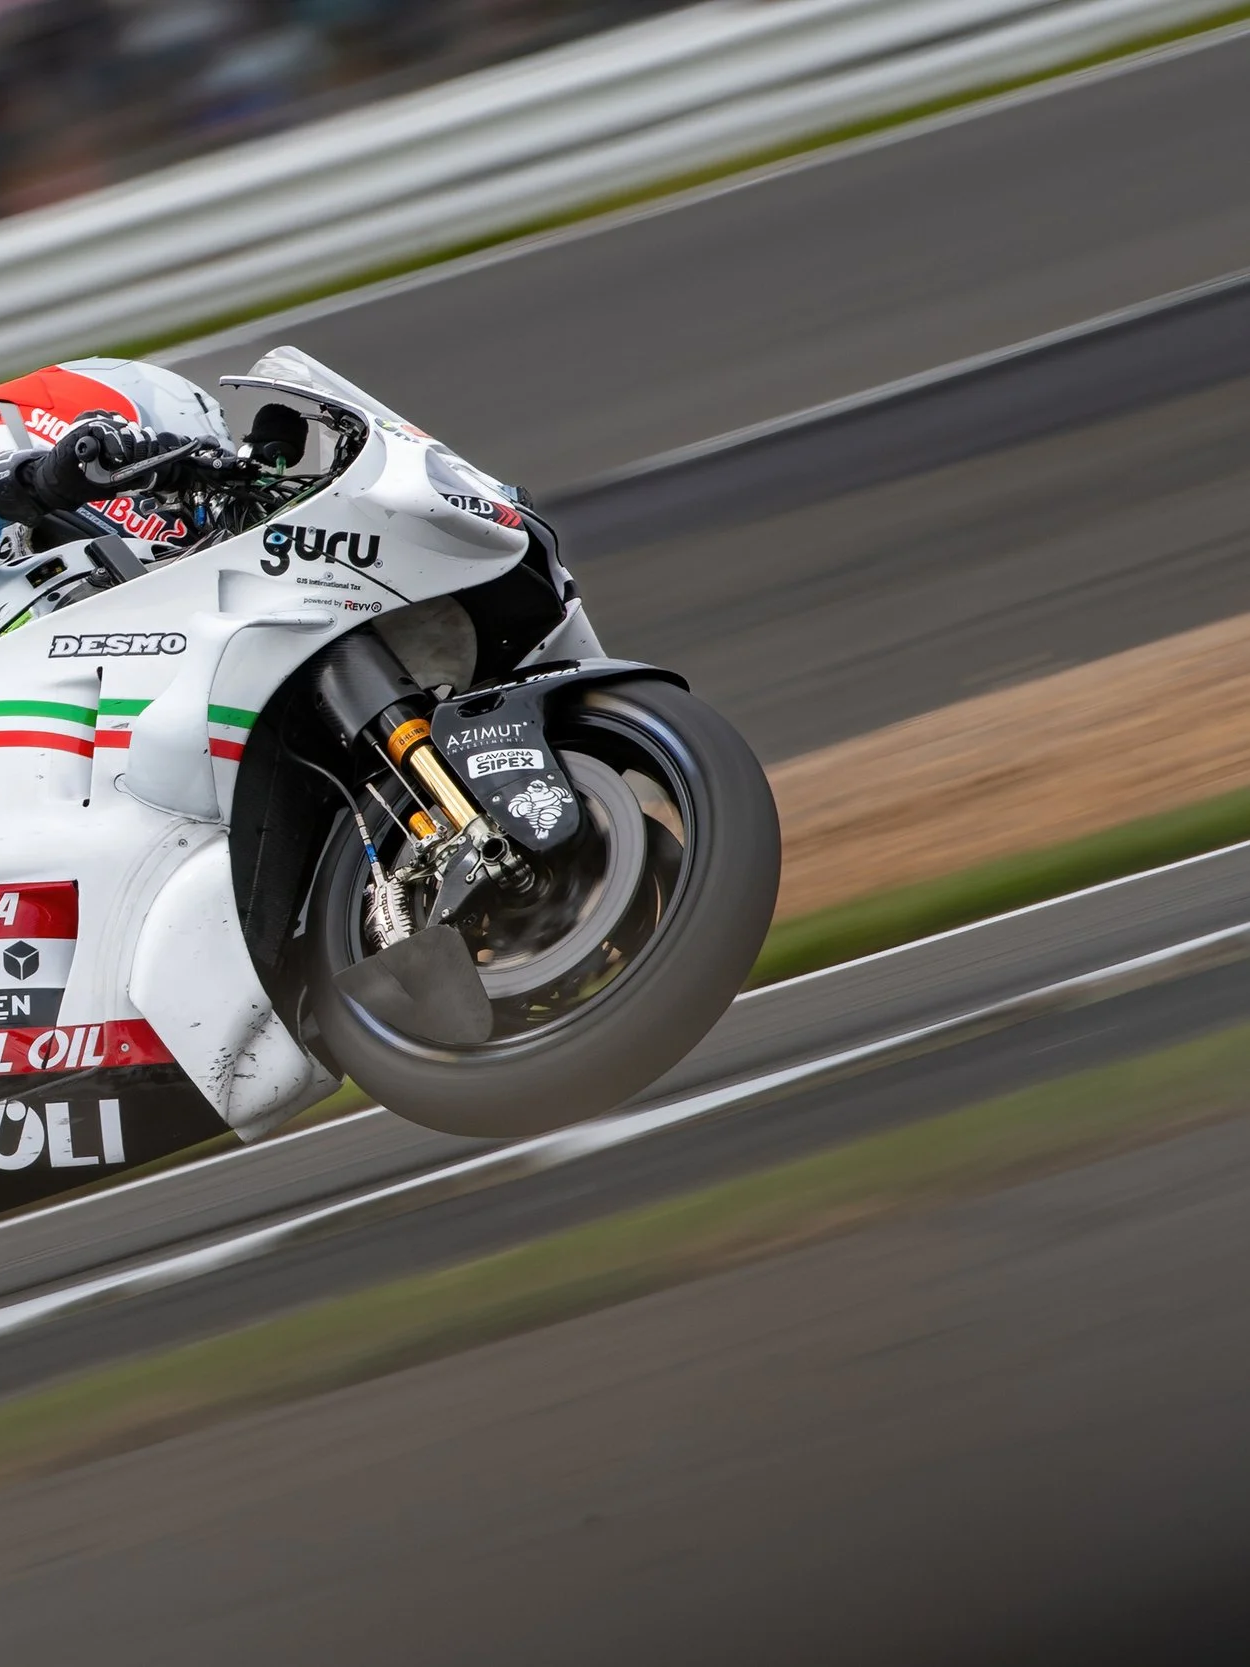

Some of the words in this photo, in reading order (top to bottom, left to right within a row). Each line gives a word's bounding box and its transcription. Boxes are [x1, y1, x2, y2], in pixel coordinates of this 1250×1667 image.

[24, 407, 70, 441] SHO
[260, 523, 381, 577] guru
[334, 599, 343, 607] by
[48, 632, 187, 658] DESMO
[446, 724, 522, 749] AZIMUT
[475, 750, 533, 763] CAVAGNA
[476, 757, 535, 775] SIPEX
[27, 1025, 105, 1070] OIL
